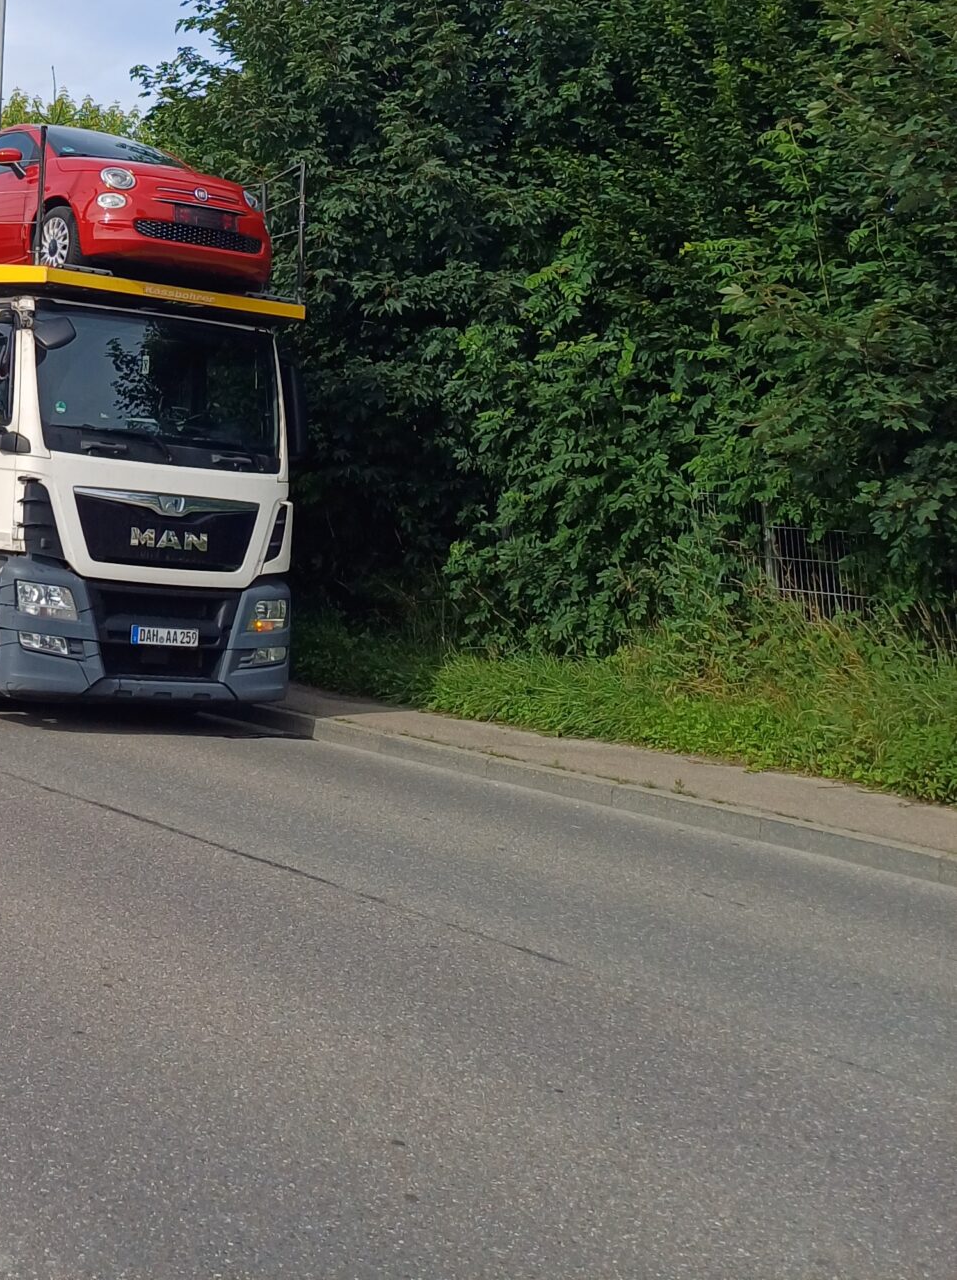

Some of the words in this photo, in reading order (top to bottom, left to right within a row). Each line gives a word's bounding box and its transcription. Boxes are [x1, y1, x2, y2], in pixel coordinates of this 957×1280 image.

[130, 526, 208, 552] MAN
[139, 628, 159, 643] DAH
[165, 630, 178, 644] AA
[180, 631, 198, 645] 259
